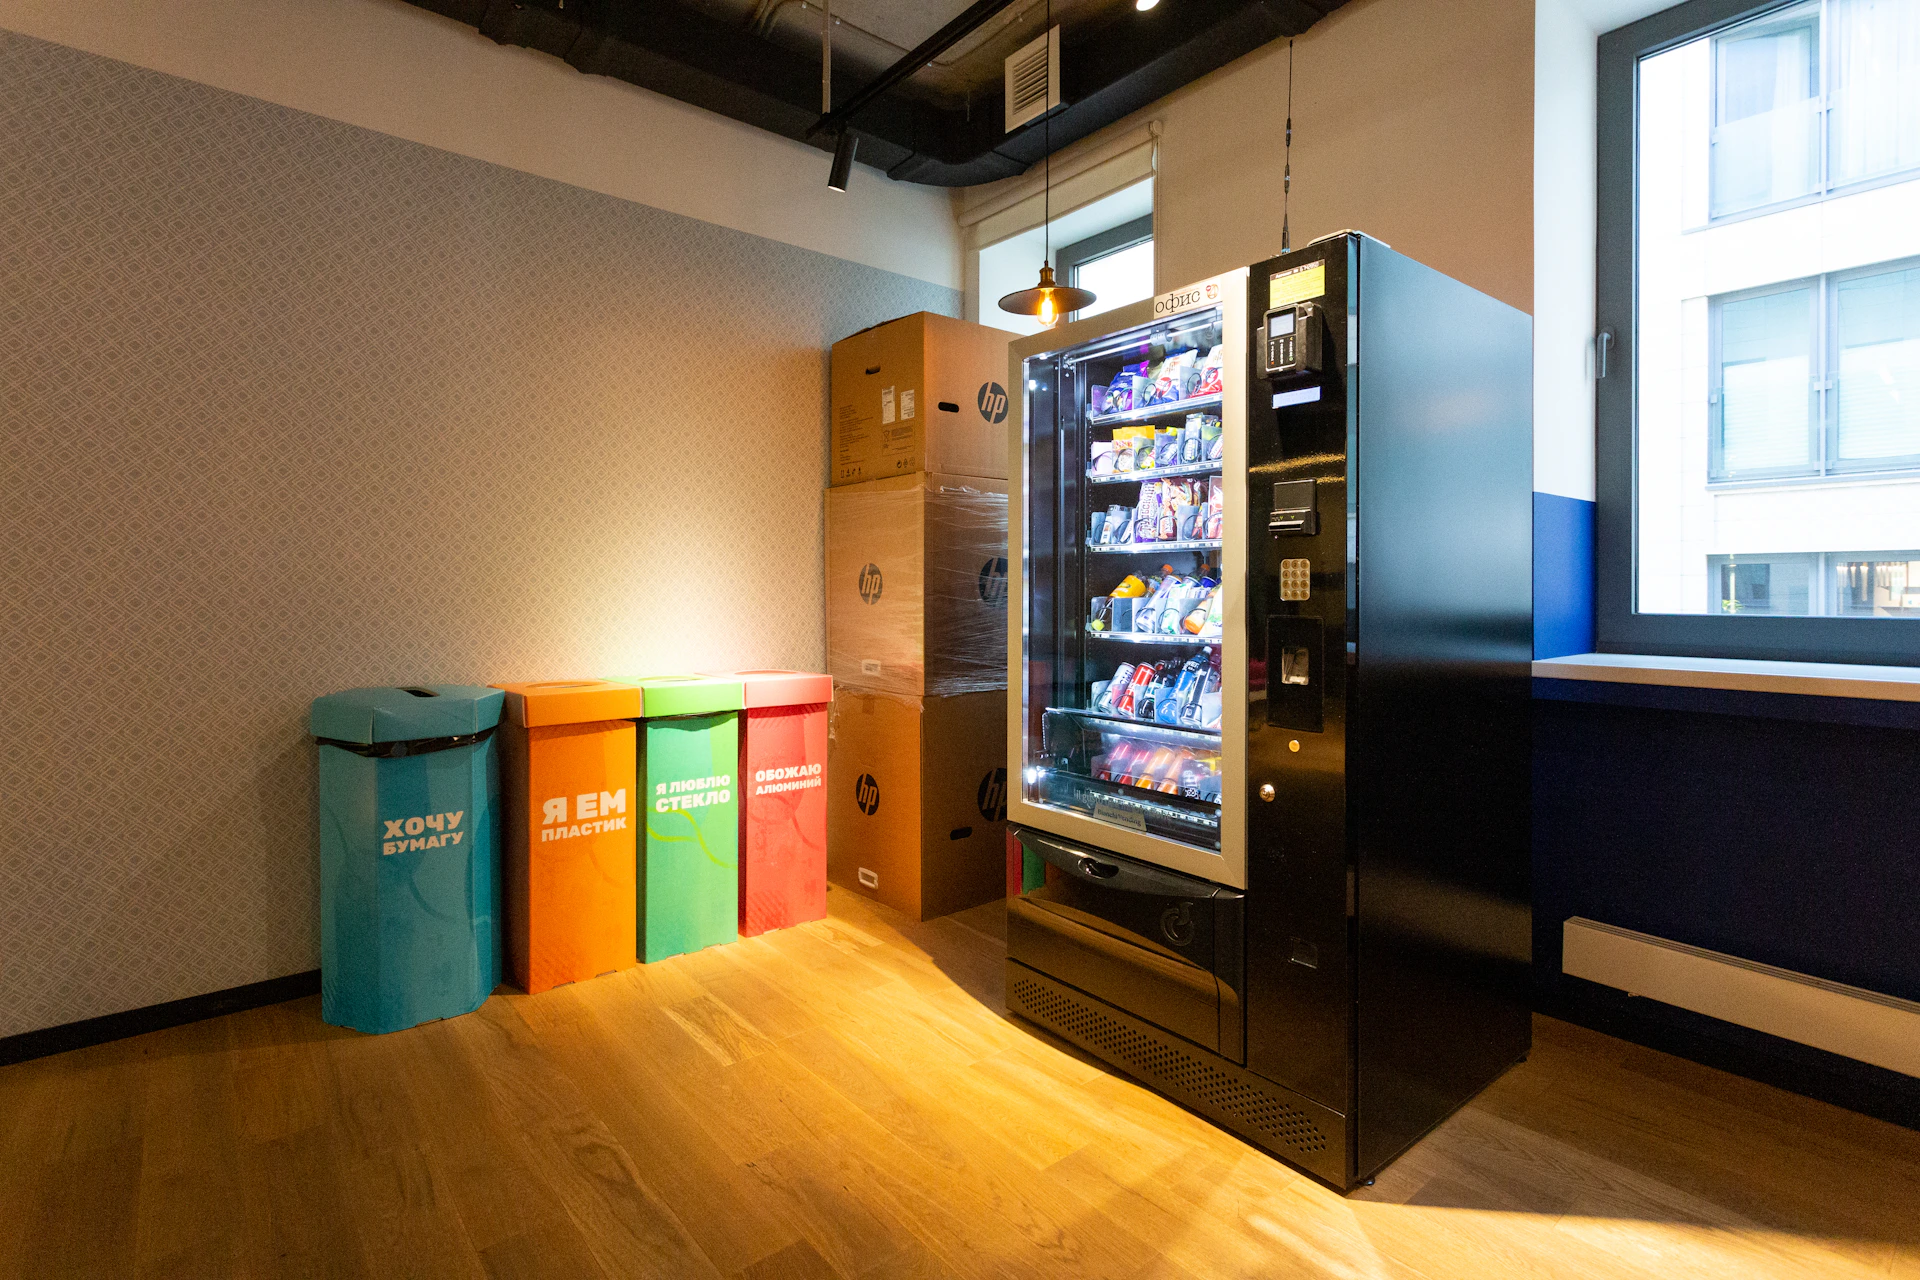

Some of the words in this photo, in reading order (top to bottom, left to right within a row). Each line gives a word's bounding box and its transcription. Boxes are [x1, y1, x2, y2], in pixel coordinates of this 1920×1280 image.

[1155, 290, 1201, 313] офис
[980, 382, 1007, 424] hp
[862, 563, 881, 605] hp
[655, 782, 666, 796] Я
[669, 774, 731, 794] ЛЮБЛЮ
[755, 763, 822, 783] ОБОЖАЮ
[755, 776, 822, 796] АЛЮМИНИЙ
[858, 773, 878, 815] hp
[542, 796, 568, 825] Я
[576, 788, 626, 820] ЕМ
[655, 789, 731, 813] СТЕКЛО
[383, 810, 464, 840] ХОЧУ
[541, 816, 627, 842] ПЛАСТИК
[383, 831, 464, 856] БУМАГУ
